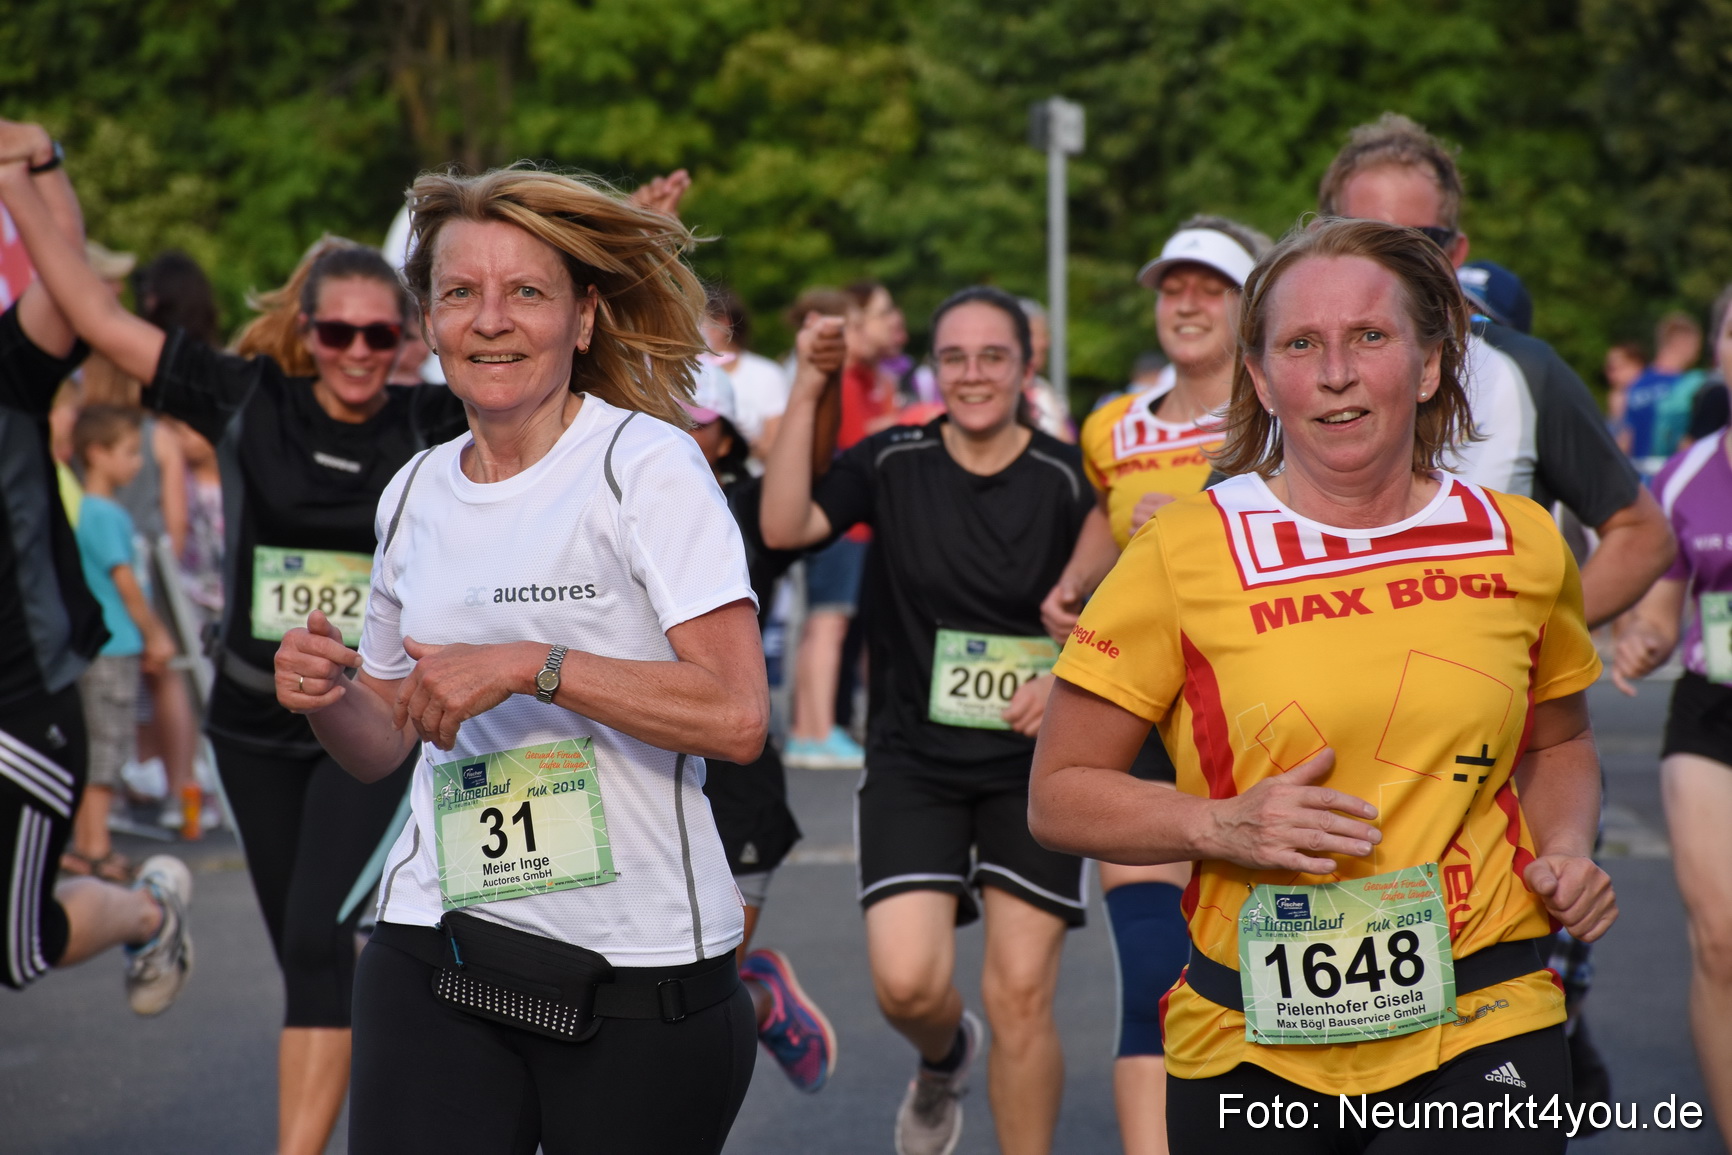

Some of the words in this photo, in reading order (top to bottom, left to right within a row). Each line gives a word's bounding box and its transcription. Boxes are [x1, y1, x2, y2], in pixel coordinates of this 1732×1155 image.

[271, 583, 362, 618] 1982
[493, 583, 597, 603] auctores
[1248, 587, 1374, 635] MAX
[1385, 568, 1519, 610] BÖGL
[948, 667, 1038, 702] 200
[454, 778, 511, 803] firmenlauf
[552, 778, 585, 795] 2019
[479, 801, 537, 859] 31
[482, 860, 516, 876] Meier
[520, 855, 550, 871] Inge
[482, 876, 521, 888] Auctores
[523, 869, 552, 882] GmbH
[1265, 912, 1345, 932] firmenlauf
[1397, 909, 1432, 928] 2019
[1265, 929, 1425, 999] 1648
[1276, 1000, 1369, 1016] Pielenhofer
[1373, 990, 1424, 1008] Gisela
[1276, 1019, 1298, 1029] Max
[1301, 1018, 1325, 1031] Bögl
[1329, 1014, 1391, 1027] Bauservice
[1393, 1004, 1426, 1019] GmbH
[1484, 1073, 1527, 1089] adidas
